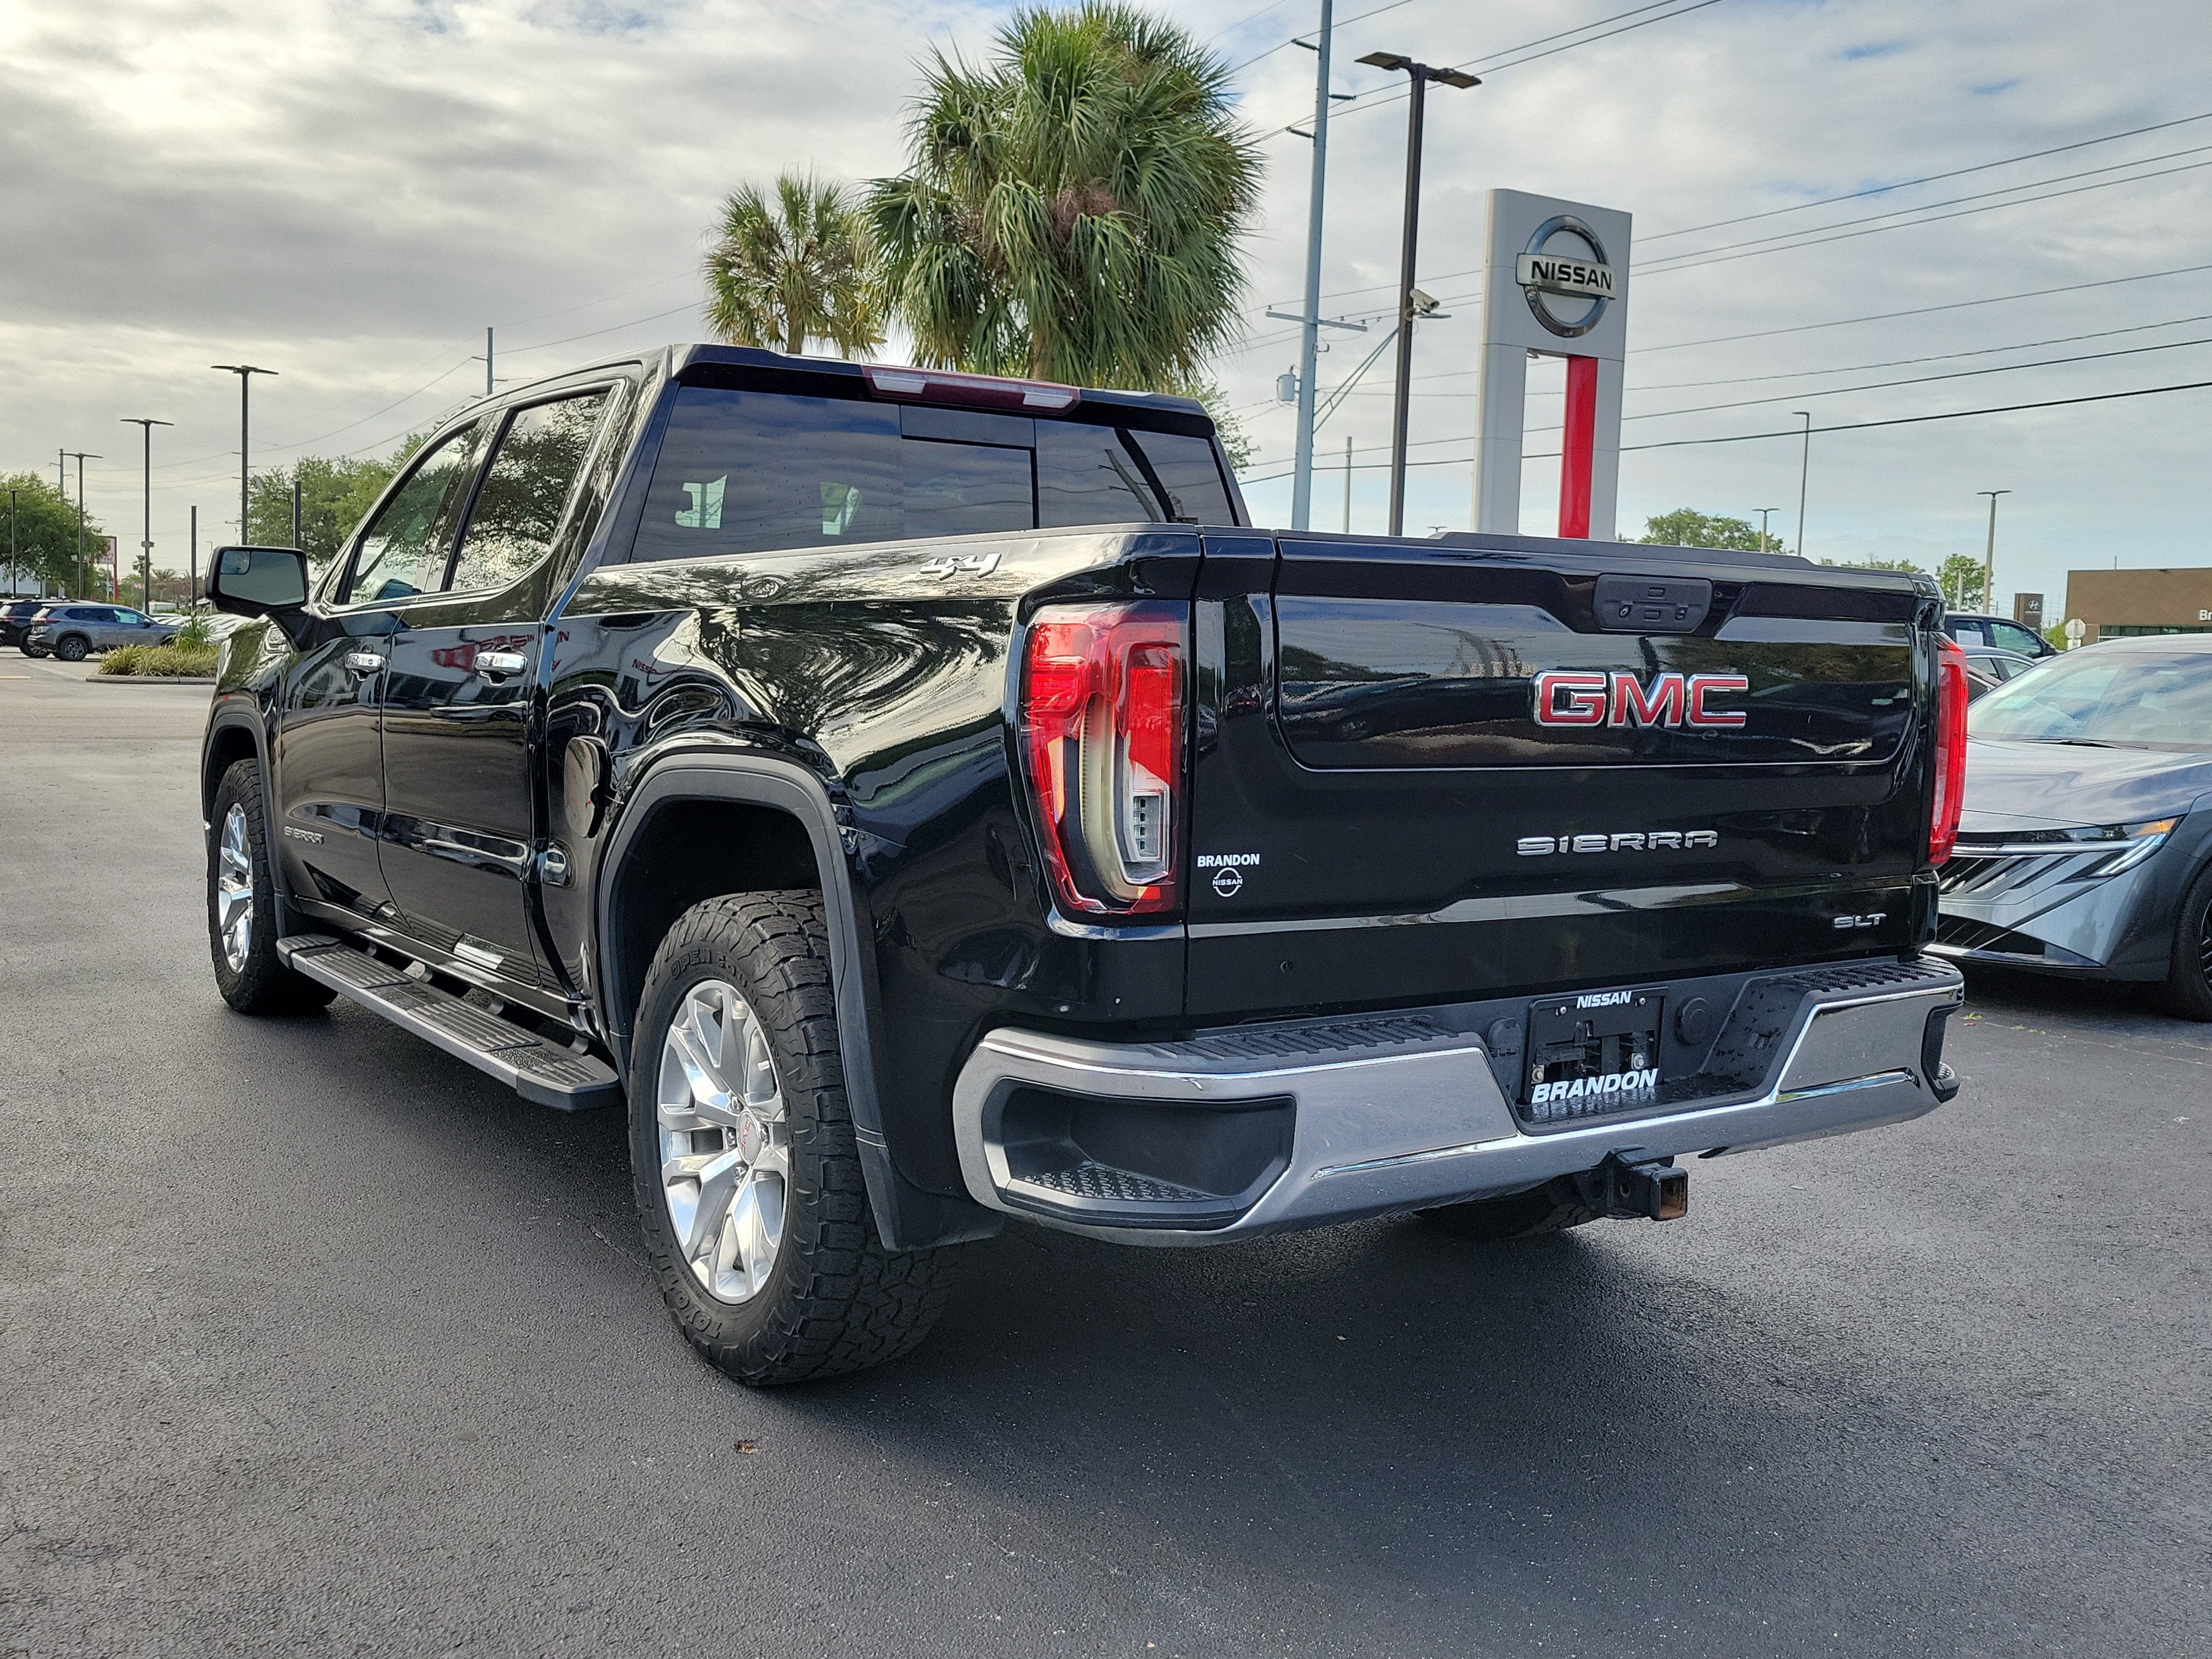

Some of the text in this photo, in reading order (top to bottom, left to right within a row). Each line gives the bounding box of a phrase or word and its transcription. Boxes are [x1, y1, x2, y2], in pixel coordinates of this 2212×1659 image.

[1531, 261, 1612, 290] NISSAN
[1532, 670, 1748, 729] GMC
[284, 825, 324, 844] SIERRA
[1516, 830, 1718, 856] SIERRA
[1197, 854, 1260, 867] BRANDON
[1832, 913, 1887, 929] SLT
[1576, 990, 1632, 1009] NISSAN
[1531, 1068, 1659, 1104] BRANDON
